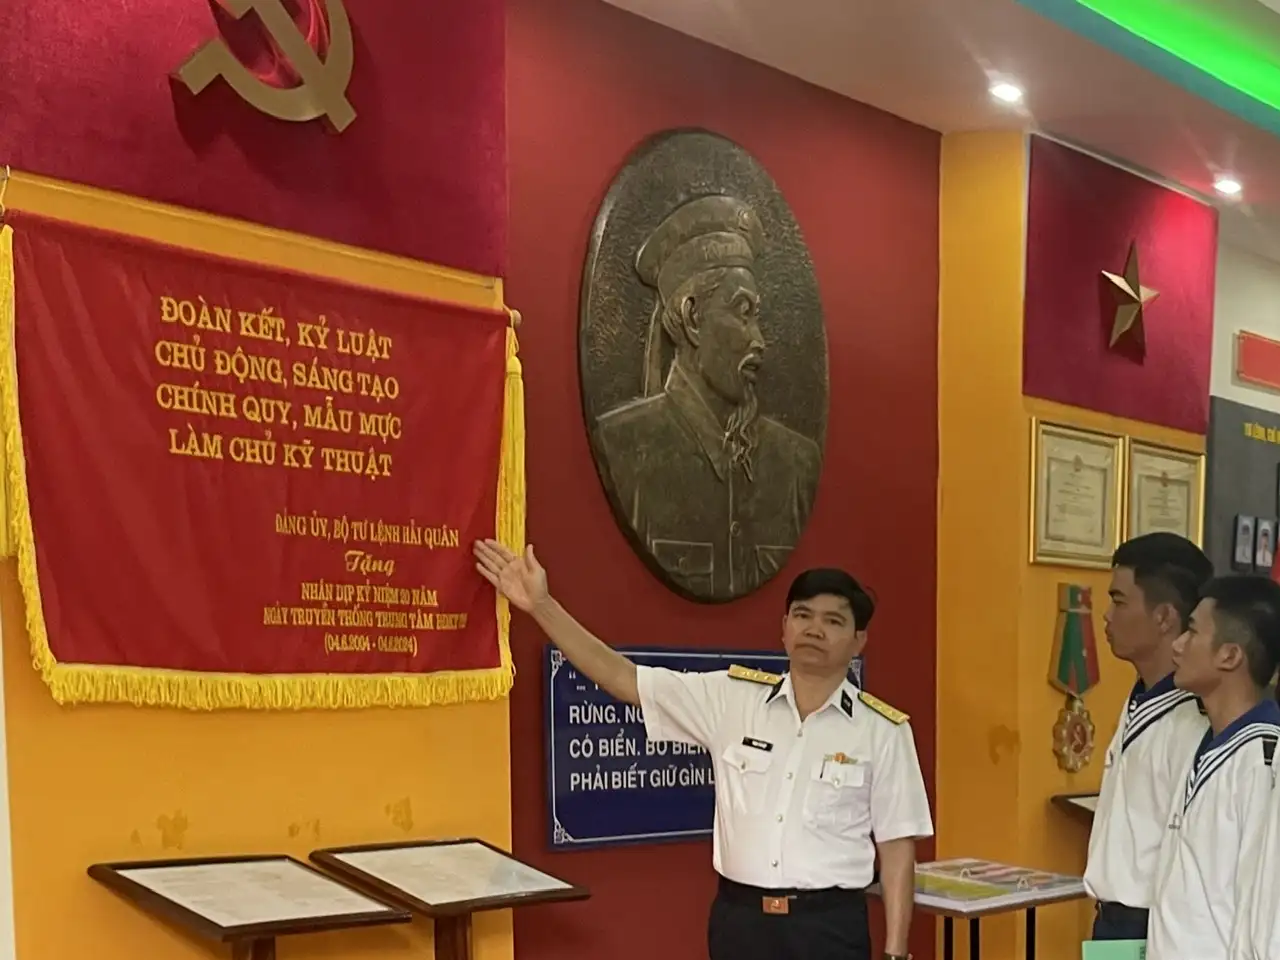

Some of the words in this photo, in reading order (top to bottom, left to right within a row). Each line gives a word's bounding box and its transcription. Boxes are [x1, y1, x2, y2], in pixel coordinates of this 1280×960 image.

[160, 295, 232, 333] ĐOÀN
[238, 306, 290, 347] KẾT,
[297, 314, 330, 349] KỶ
[336, 328, 392, 363] LUẬT
[155, 334, 206, 372] CHỦ
[213, 346, 288, 389] ĐỘNG,
[292, 356, 354, 394] SÁNG
[357, 371, 399, 403] TẠO
[157, 381, 238, 418] CHÍNH
[243, 395, 297, 431] QUY,
[303, 396, 354, 433] MẪU
[358, 412, 402, 444] MỰC
[169, 422, 224, 460] LÀM
[229, 429, 277, 465] CHỦ
[283, 439, 315, 468] KỸ
[321, 446, 392, 481] THUẬT
[344, 549, 395, 577] Tặng
[569, 699, 621, 724] RỪNG.
[569, 733, 594, 759] CÓ
[598, 727, 640, 757] BIỂN.
[570, 764, 608, 791] PHẢI
[611, 762, 647, 790] BIẾT
[650, 764, 678, 788] GIỮ
[679, 762, 705, 786] GÌN
